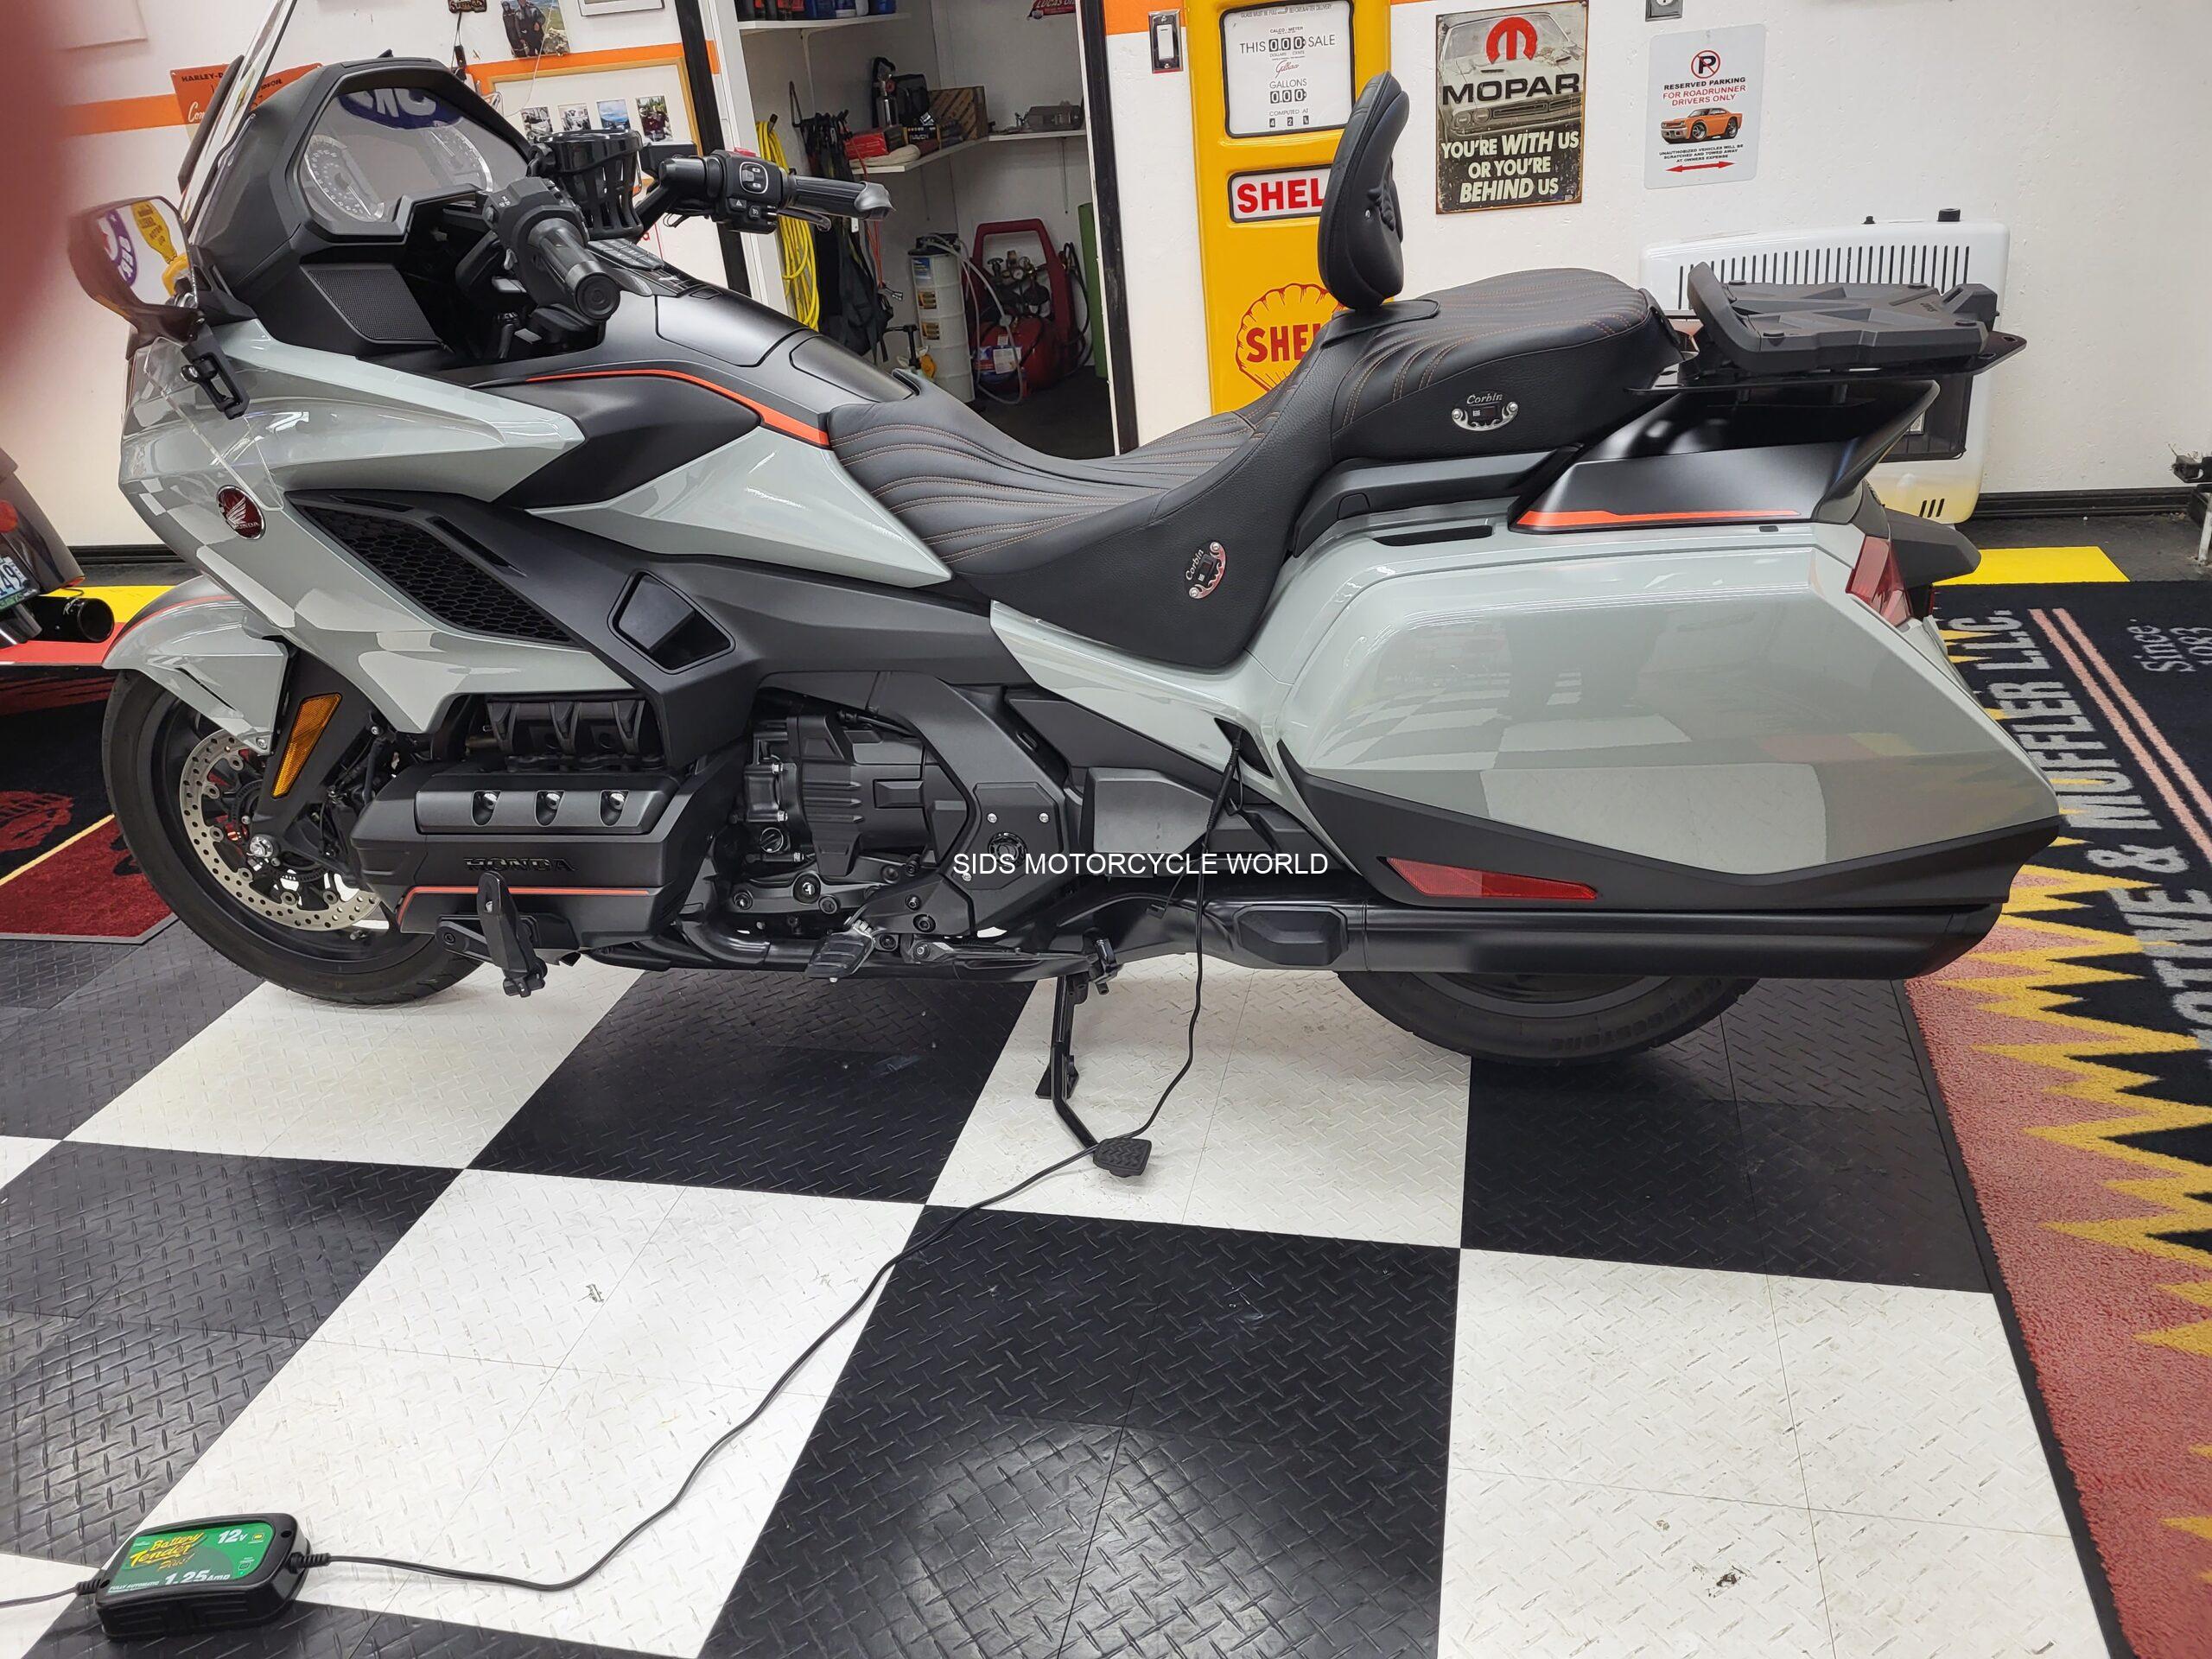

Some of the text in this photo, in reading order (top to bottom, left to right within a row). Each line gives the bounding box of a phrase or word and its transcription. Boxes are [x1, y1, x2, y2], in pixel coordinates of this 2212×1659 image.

[1240, 41, 1266, 54] THIS
[1308, 35, 1335, 47] SALE
[1270, 79, 1306, 88] GALLONS
[1442, 73, 1580, 105] MOPAR
[1664, 77, 1745, 90] RESERVED PARKING
[1683, 85, 1745, 98] ROADRUNNER
[1672, 93, 1736, 105] DRIVERS ONLY
[1440, 131, 1580, 159] YOU'RE WITH US
[1468, 156, 1551, 179] OR YOU'RE
[1236, 178, 1325, 213] SHEL
[1459, 177, 1559, 203] BEHIND US
[1246, 323, 1321, 363] SHE
[1466, 392, 1503, 404] Corbin
[1185, 549, 1204, 580] Corbin
[1989, 681, 2161, 829] MUFFLER
[463, 857, 577, 871] HONDA
[2088, 844, 2190, 874] &
[150, 1533, 204, 1551] Battery
[130, 1545, 192, 1567] Tender
